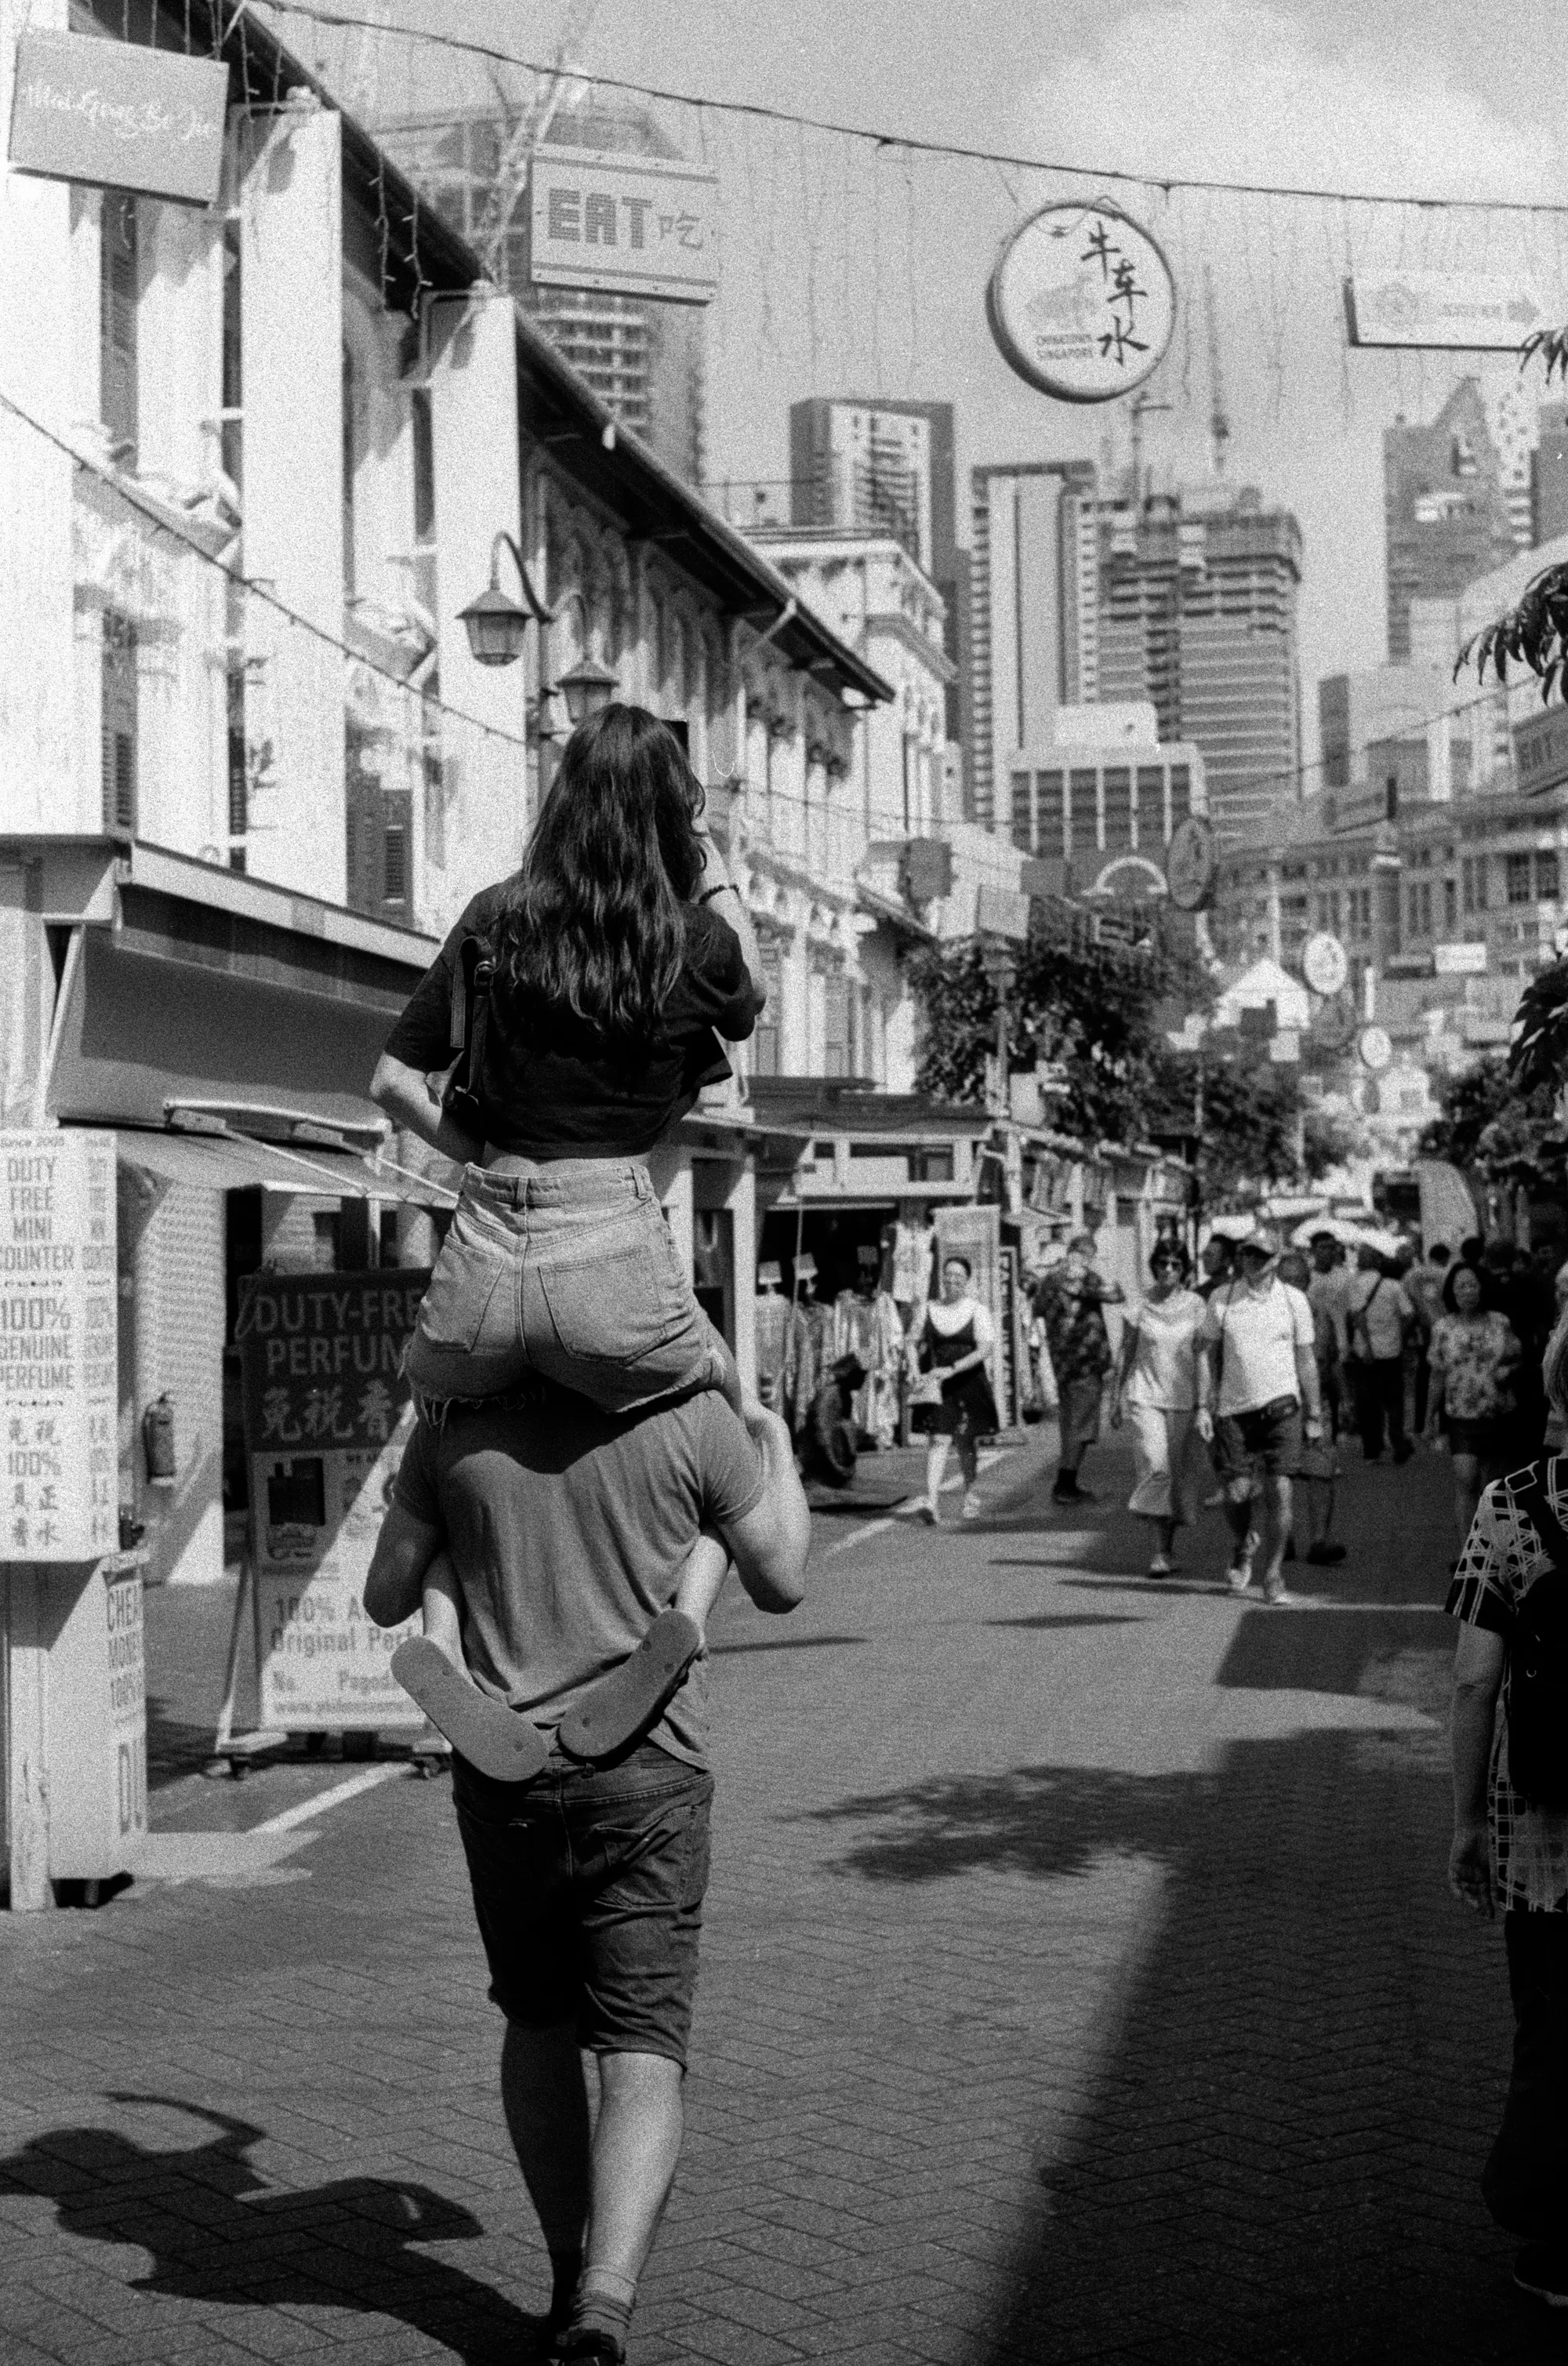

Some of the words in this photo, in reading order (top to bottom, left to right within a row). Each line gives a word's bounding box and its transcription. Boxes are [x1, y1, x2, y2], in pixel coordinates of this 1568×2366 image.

[548, 187, 653, 249] EAT
[659, 210, 704, 251] 吃
[1080, 220, 1149, 366] 牛车水
[1036, 347, 1094, 361] SINGAPORE
[8, 1156, 59, 1183] DUTY
[10, 1186, 55, 1212] FREE
[13, 1217, 53, 1242] MINI
[0, 1245, 74, 1272] OUNTER
[2, 1297, 71, 1331] 100%
[0, 1335, 74, 1361] GENUINE
[8, 1451, 62, 1477] 100%
[277, 1597, 336, 1622] 100%
[271, 1626, 357, 1658] Original
